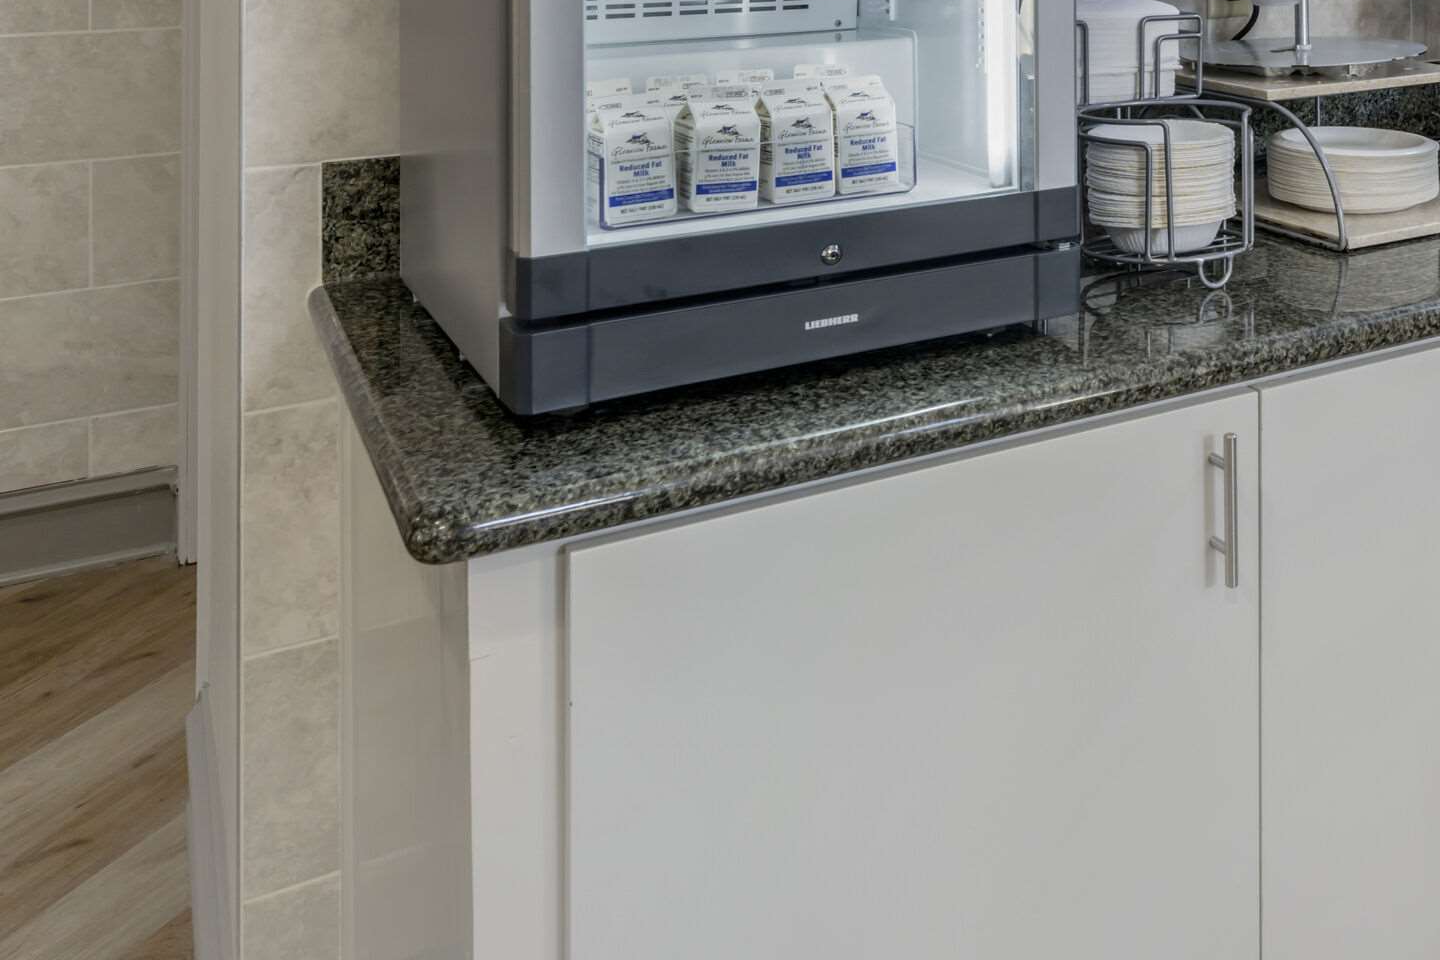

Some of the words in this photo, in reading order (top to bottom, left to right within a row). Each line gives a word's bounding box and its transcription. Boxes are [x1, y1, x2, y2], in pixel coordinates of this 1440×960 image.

[850, 138, 876, 146] Reduced
[785, 146, 812, 154] Reduced
[708, 154, 738, 162] Reduced
[619, 162, 650, 172] Reduced
[651, 160, 662, 168] Fat
[633, 169, 649, 177] Milk
